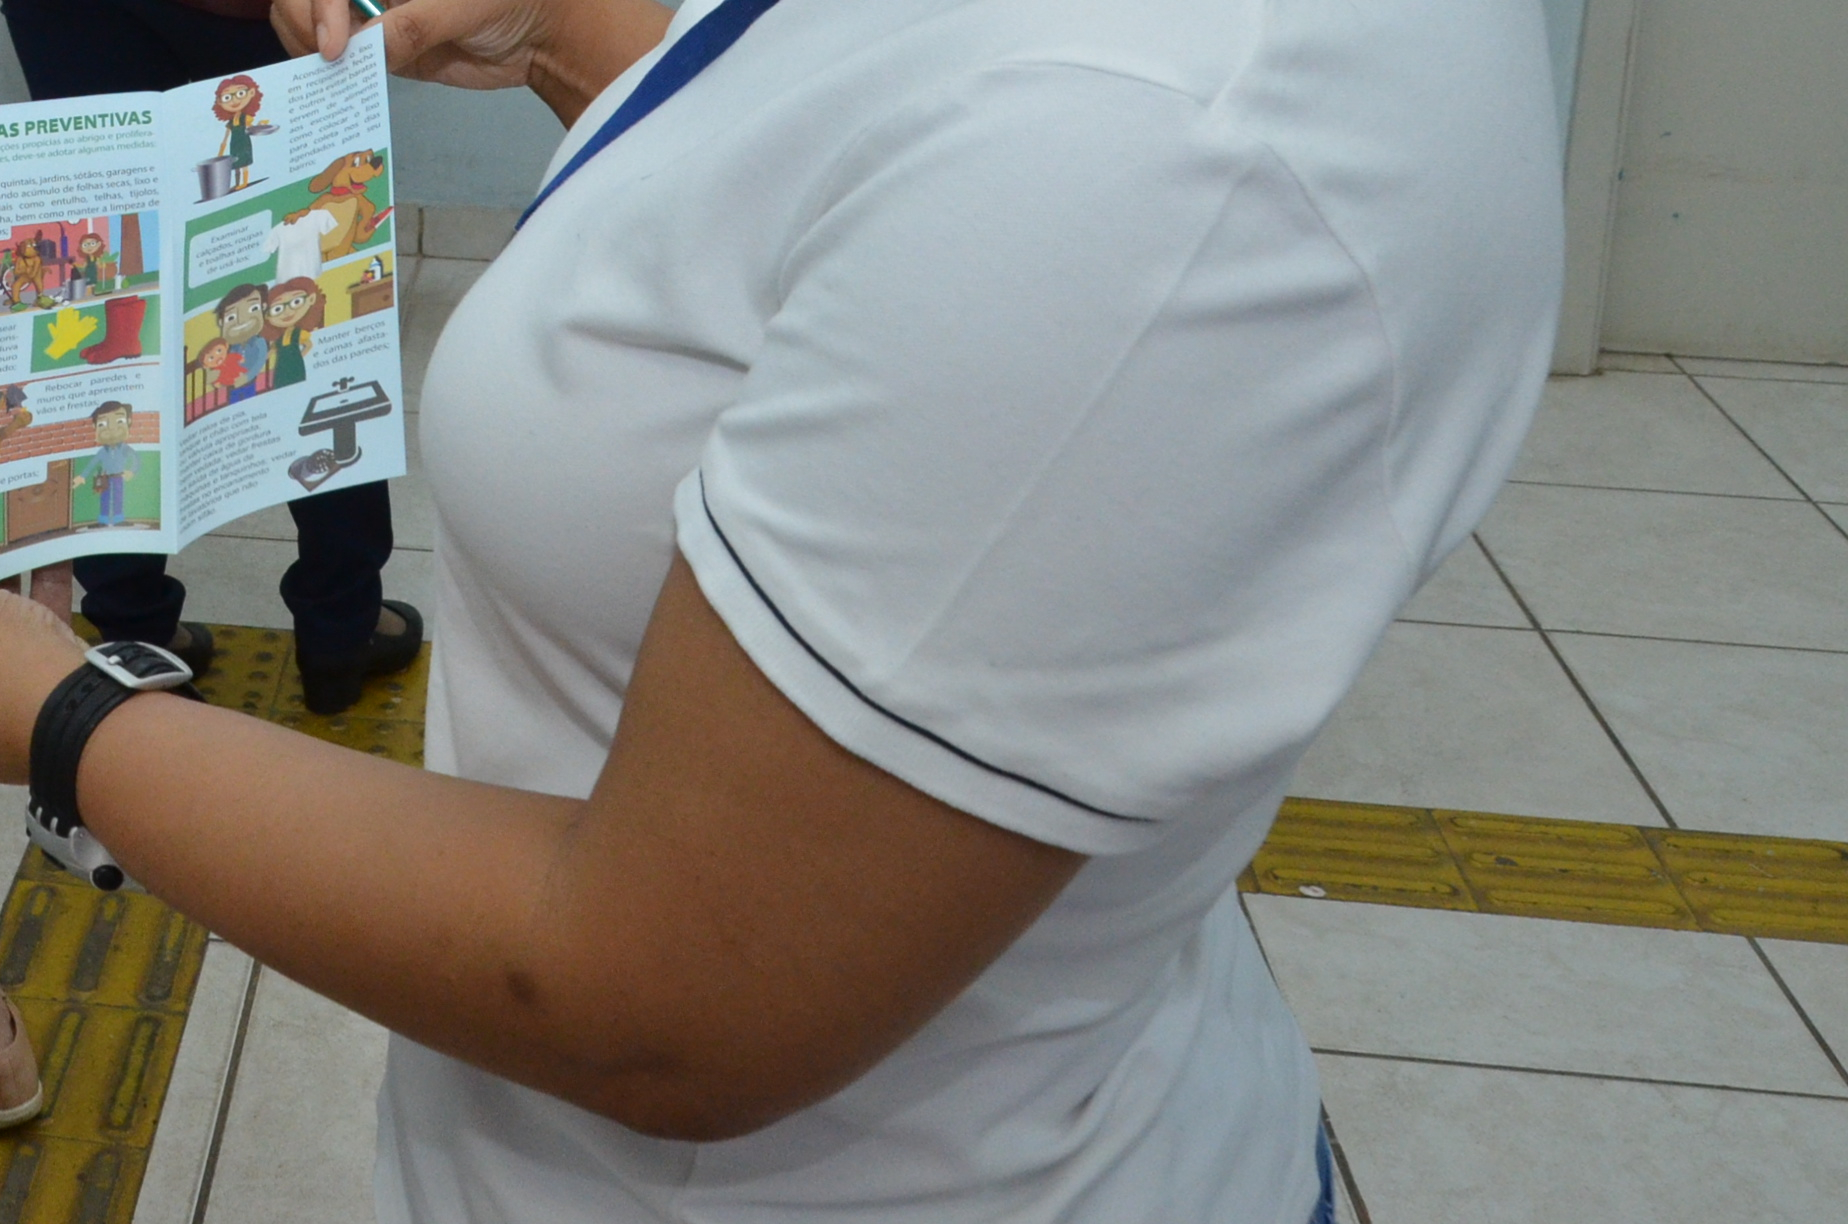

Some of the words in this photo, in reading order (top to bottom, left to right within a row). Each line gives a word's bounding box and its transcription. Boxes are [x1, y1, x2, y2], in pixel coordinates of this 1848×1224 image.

[25, 110, 152, 136] PREVENTIVAS
[12, 152, 46, 162] deve-se
[47, 148, 75, 158] adotar
[78, 144, 114, 155] algumas
[117, 140, 156, 150] medidas:
[21, 136, 61, 150] propícias
[77, 134, 105, 143] abrigo
[116, 130, 155, 140] prolifera-
[0, 178, 38, 189] quintais,
[38, 173, 72, 186] jardins,
[73, 171, 105, 180] sótãos,
[106, 165, 148, 177] garagens
[21, 186, 60, 198] acúmulo
[76, 183, 103, 192] folhas
[106, 179, 132, 189] secas,
[134, 178, 151, 186] lixo
[19, 200, 45, 210] como
[51, 196, 88, 207] entulho,
[94, 192, 123, 202] telhas,
[130, 188, 159, 198] tijolos,
[15, 213, 37, 222] bem
[38, 209, 64, 219] como
[67, 206, 99, 216] manter
[110, 202, 146, 212] limpeza
[148, 199, 160, 207] de
[211, 226, 248, 244] Examinar
[318, 330, 350, 345] Manter
[354, 321, 386, 334] berços
[323, 341, 353, 355] camas
[358, 332, 388, 345] afasta-
[0, 344, 18, 353] luva
[313, 360, 330, 369] dos
[331, 354, 348, 364] das
[350, 343, 390, 359] paredes;
[37, 395, 66, 405] muros
[68, 391, 86, 401] que
[88, 383, 145, 397] apresentem
[45, 381, 82, 393] Rebocar
[90, 373, 128, 386] paredes
[36, 406, 57, 416] vãos
[67, 399, 100, 411] frestas;
[7, 471, 40, 485] portas;
